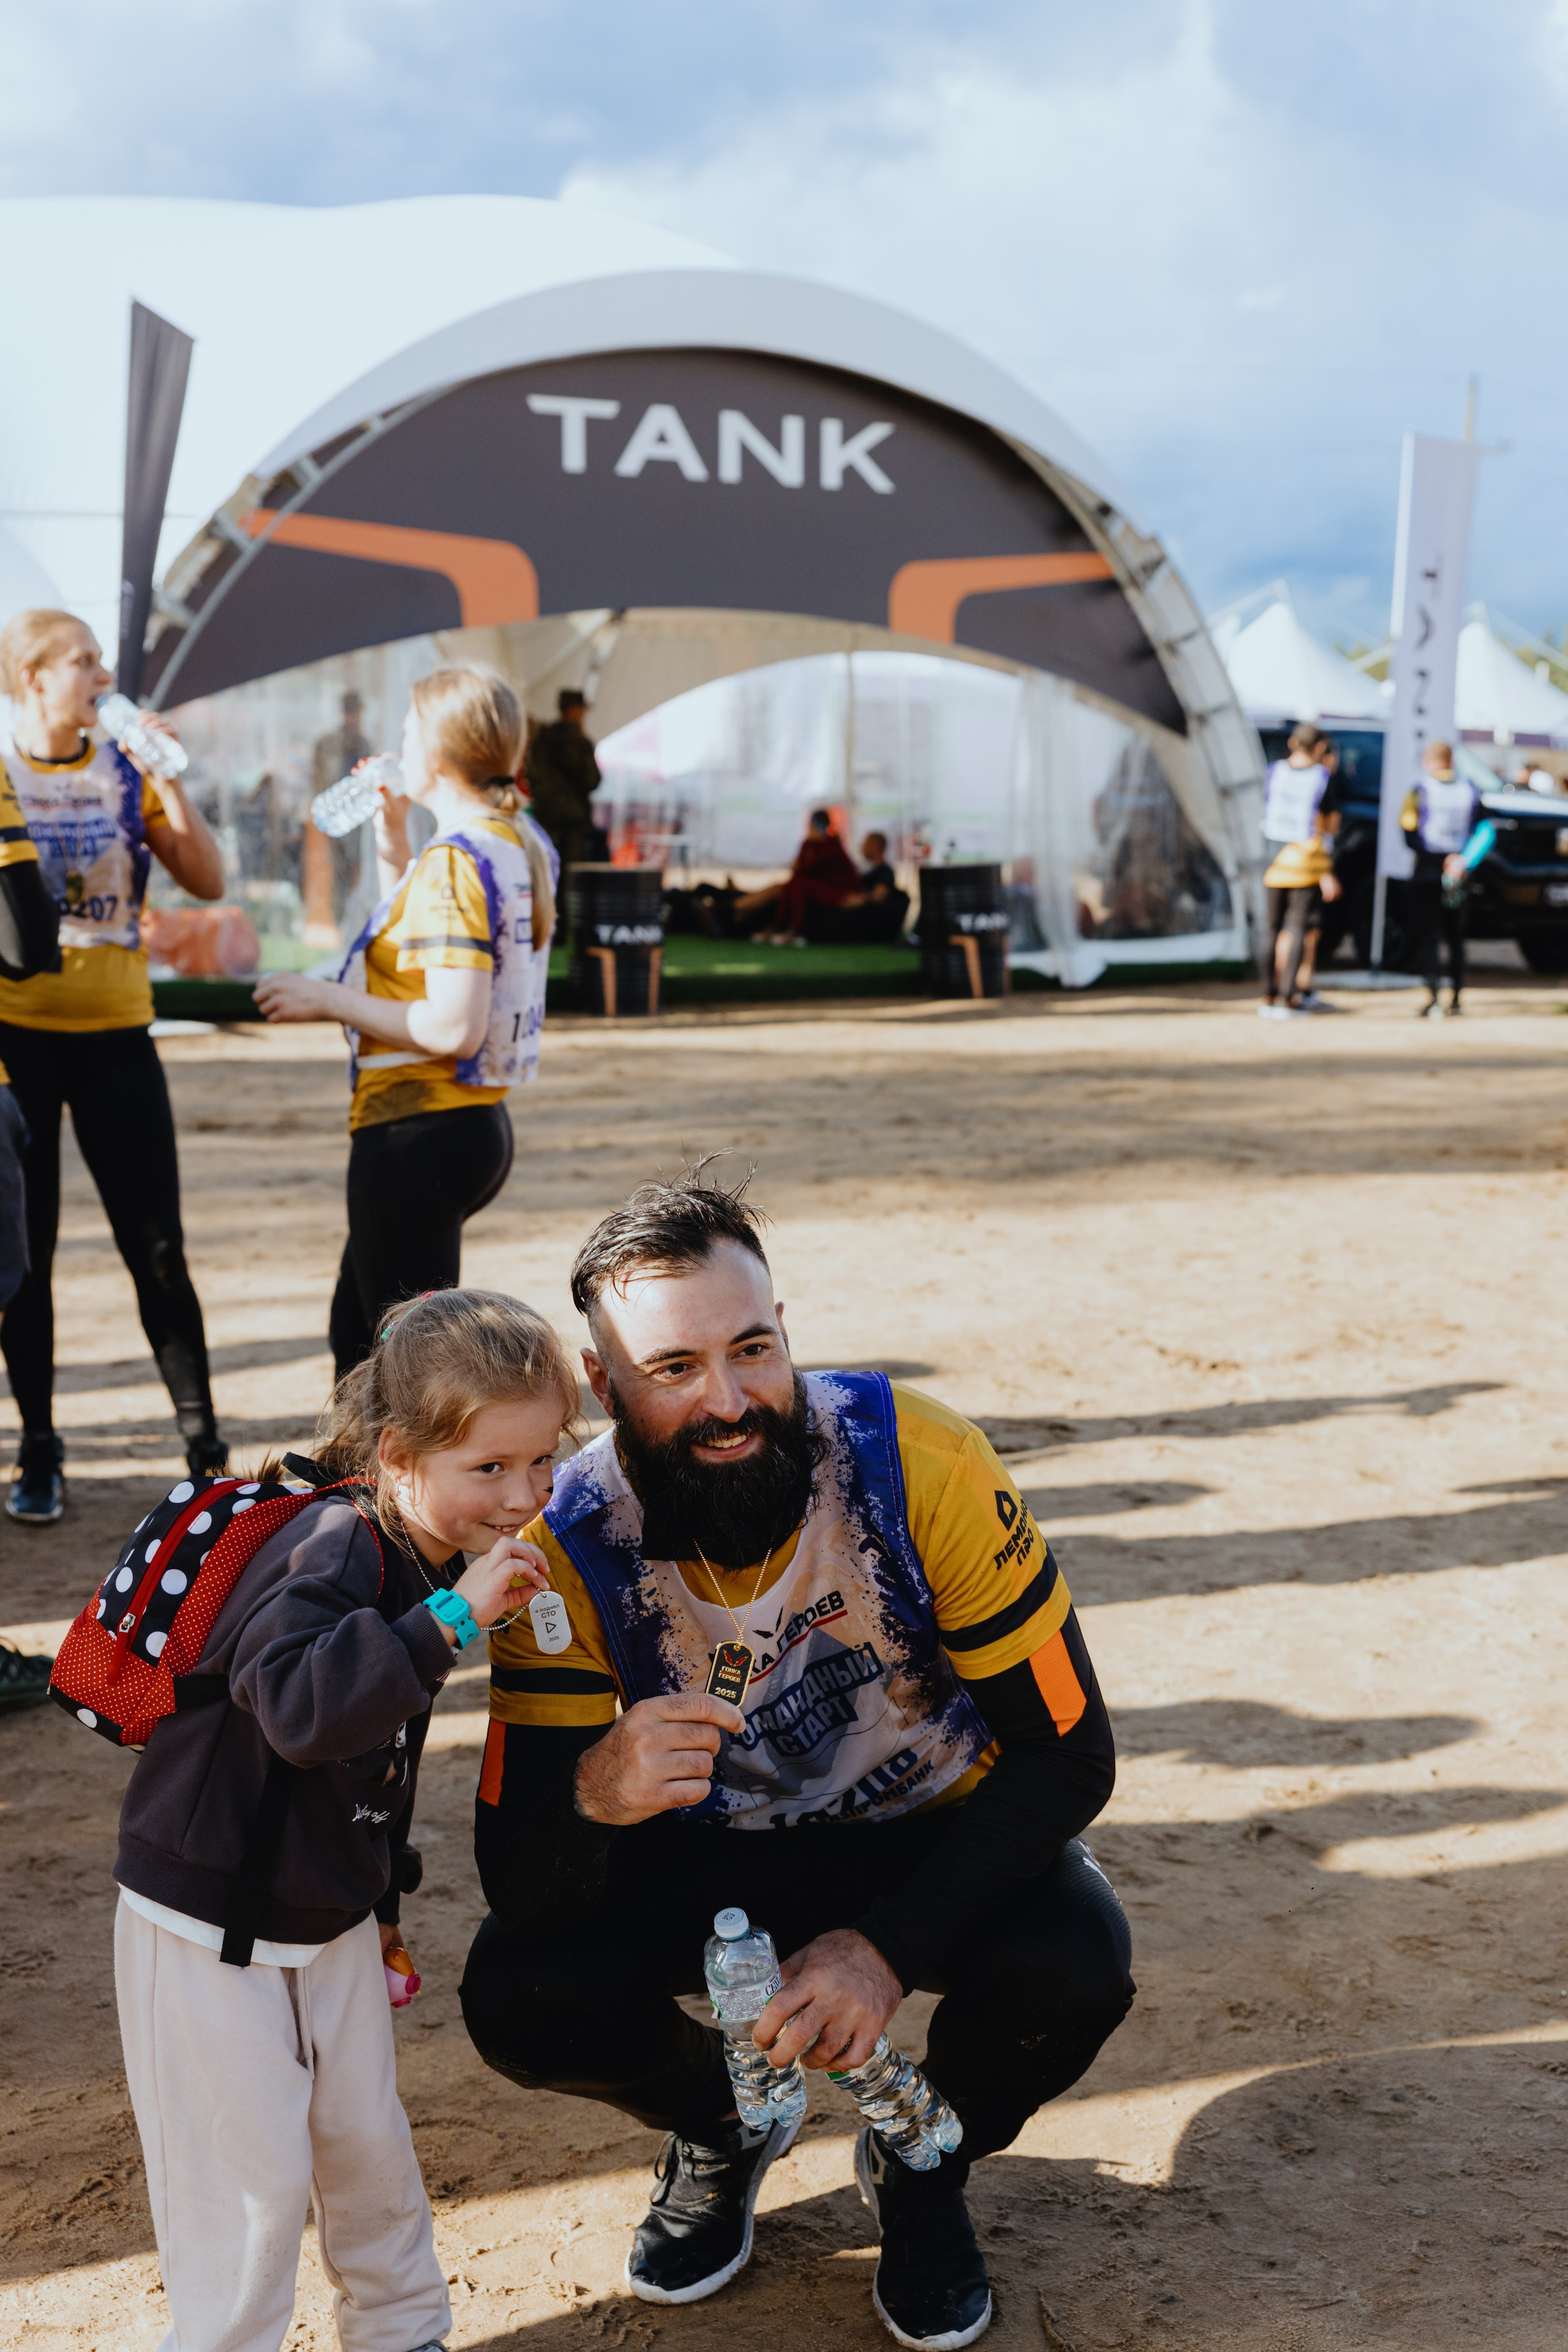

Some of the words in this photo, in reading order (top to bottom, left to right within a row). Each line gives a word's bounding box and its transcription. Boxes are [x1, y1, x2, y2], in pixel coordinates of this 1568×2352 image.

[526, 393, 895, 495] TANK
[1017, 1528, 1034, 1567] ПРО
[776, 1590, 845, 1653] ГЕРОЕВ
[714, 1687, 737, 1699] 2025
[718, 1672, 741, 1683] ГЕРОЕВ
[722, 1666, 741, 1675] ГОНКА
[734, 1643, 878, 1745] ОМАНДНЫЙ
[775, 1696, 849, 1754] СТАРТ
